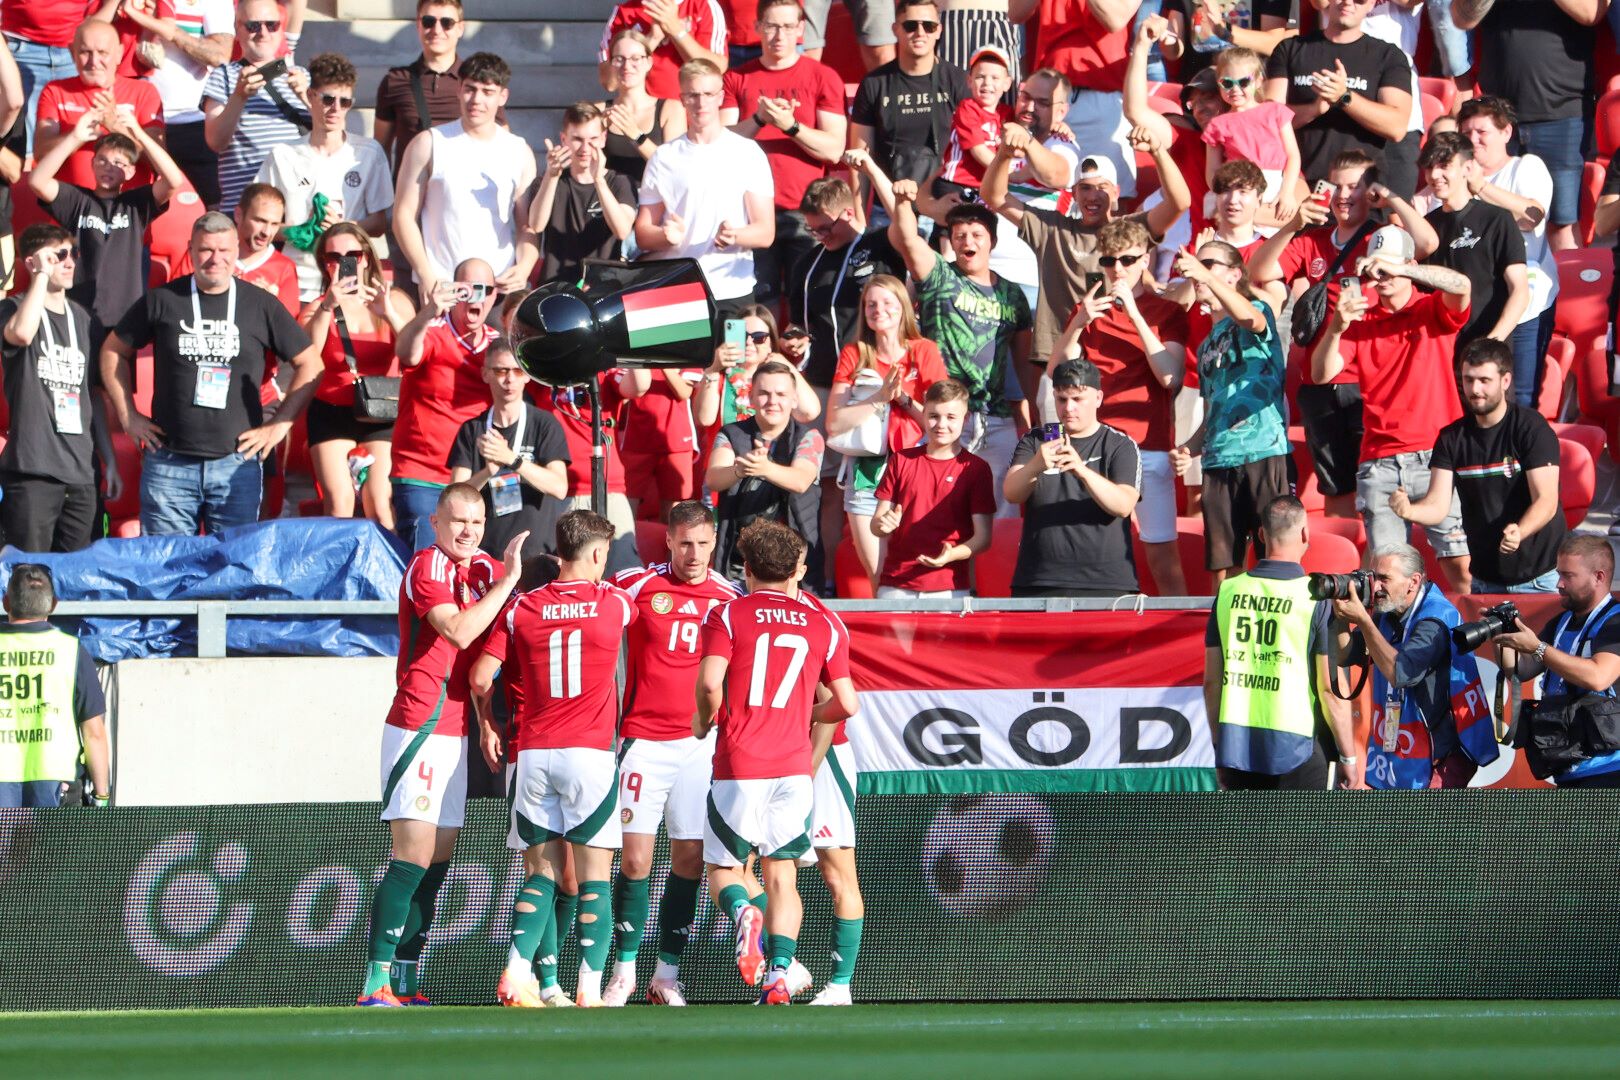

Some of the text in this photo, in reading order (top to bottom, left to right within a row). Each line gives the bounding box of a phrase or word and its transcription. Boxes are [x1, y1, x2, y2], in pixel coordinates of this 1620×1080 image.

[953, 290, 1017, 323] AWESOME
[542, 601, 599, 620] KERKEZ
[755, 608, 808, 627] STYLES
[668, 620, 699, 654] 19
[1236, 616, 1277, 647] 510
[549, 629, 582, 699] 11
[749, 632, 809, 709] 17
[0, 673, 43, 700] 591
[1222, 671, 1280, 692] STEWARD
[903, 691, 1191, 767] GÖD
[418, 761, 434, 791] 4
